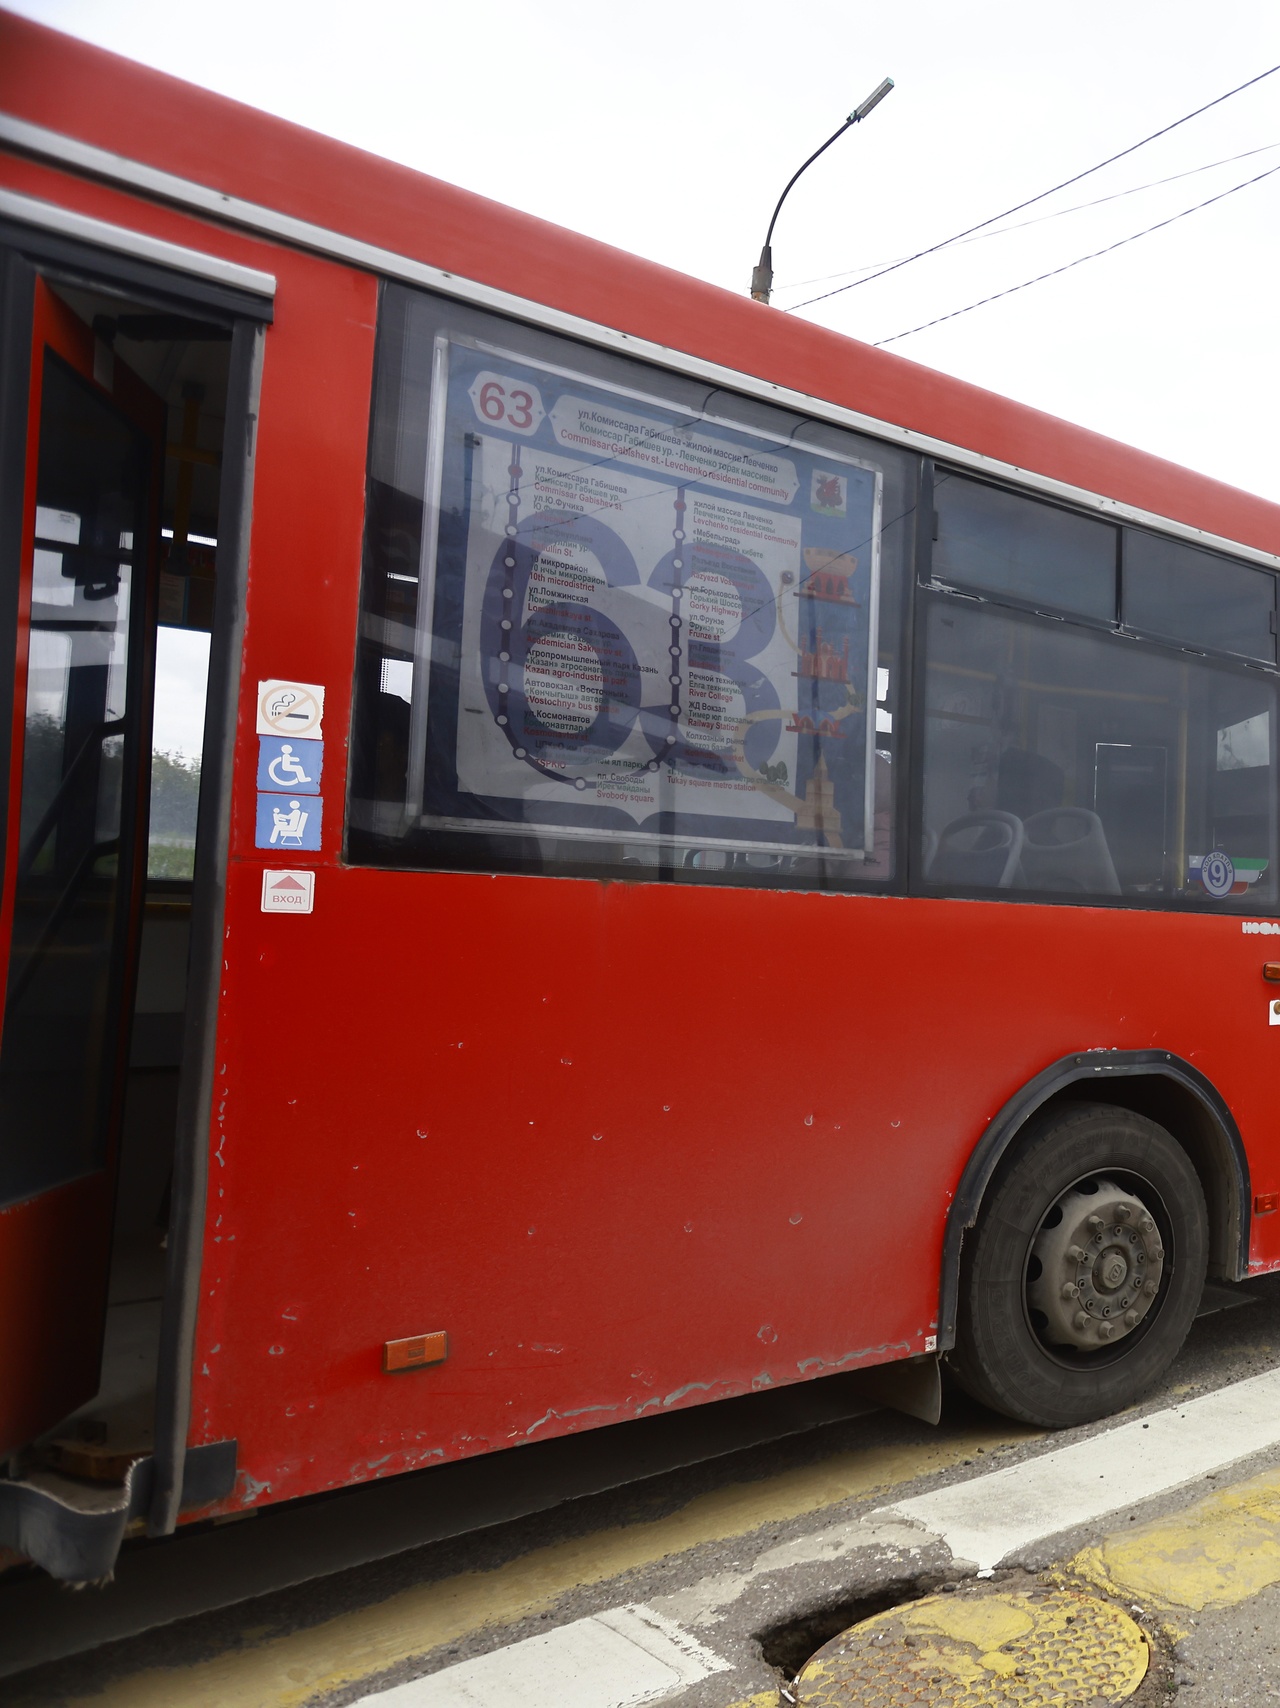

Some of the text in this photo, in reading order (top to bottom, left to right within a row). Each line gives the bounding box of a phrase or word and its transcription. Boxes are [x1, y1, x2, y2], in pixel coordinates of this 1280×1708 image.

[480, 383, 533, 428] 63
[578, 409, 638, 433] ул.Комиссара
[640, 426, 681, 446] Габишева
[713, 449, 742, 463] массив
[742, 455, 778, 473] Левченко
[579, 421, 622, 443] Комиссар
[624, 434, 661, 452] Габишев
[679, 450, 717, 469] Левченко
[718, 462, 740, 475] торак
[741, 468, 776, 484] массивы
[560, 429, 611, 451] Commissar
[611, 441, 650, 462] Gabishev
[665, 459, 707, 477] Levchenko
[708, 471, 748, 487] residential
[748, 482, 789, 500] community
[535, 465, 627, 494] ул.Комиссара Габишева
[535, 473, 572, 490] Комиссар
[575, 483, 608, 498] Габишев
[534, 482, 577, 499] Commissar
[579, 494, 612, 508] Gabishev
[534, 494, 584, 512] ул.Ю.Фучика
[694, 500, 773, 525] жилой массив Левченко
[693, 508, 776, 534] Левченко торак массивы
[693, 516, 798, 548] Levchenko residential community
[541, 558, 588, 573] микрорайон
[530, 572, 595, 592] 10th microdistrict
[540, 567, 556, 575] нчы
[558, 569, 606, 586] микрорайон
[528, 586, 589, 603] ул.Ломжинская
[690, 592, 718, 605] Горький
[690, 601, 709, 611] Gorky
[712, 606, 739, 618] Highway
[689, 614, 724, 625] ул.Фрунзе
[689, 622, 714, 632] Фрунзе
[689, 630, 712, 640] Frunze
[525, 664, 550, 675] Kazan
[552, 670, 610, 683] agro-industrial
[632, 662, 659, 675] Казань
[688, 672, 714, 682] Речной
[525, 678, 573, 691] Автовокзал
[526, 696, 576, 709] «Vostochny»
[578, 702, 592, 710] bus
[689, 689, 733, 703] River College
[688, 701, 726, 712] ЖД Вокзал
[688, 710, 710, 720] Тимер
[688, 718, 739, 732] Railway Station
[686, 731, 725, 743] Колхозный
[686, 740, 709, 749] олхоз
[610, 772, 645, 784] Свободы
[667, 776, 687, 786] Tukay
[689, 780, 711, 788] square
[596, 790, 654, 803] Svobody square
[1211, 863, 1225, 887] 9
[272, 895, 302, 905] ВХОД
